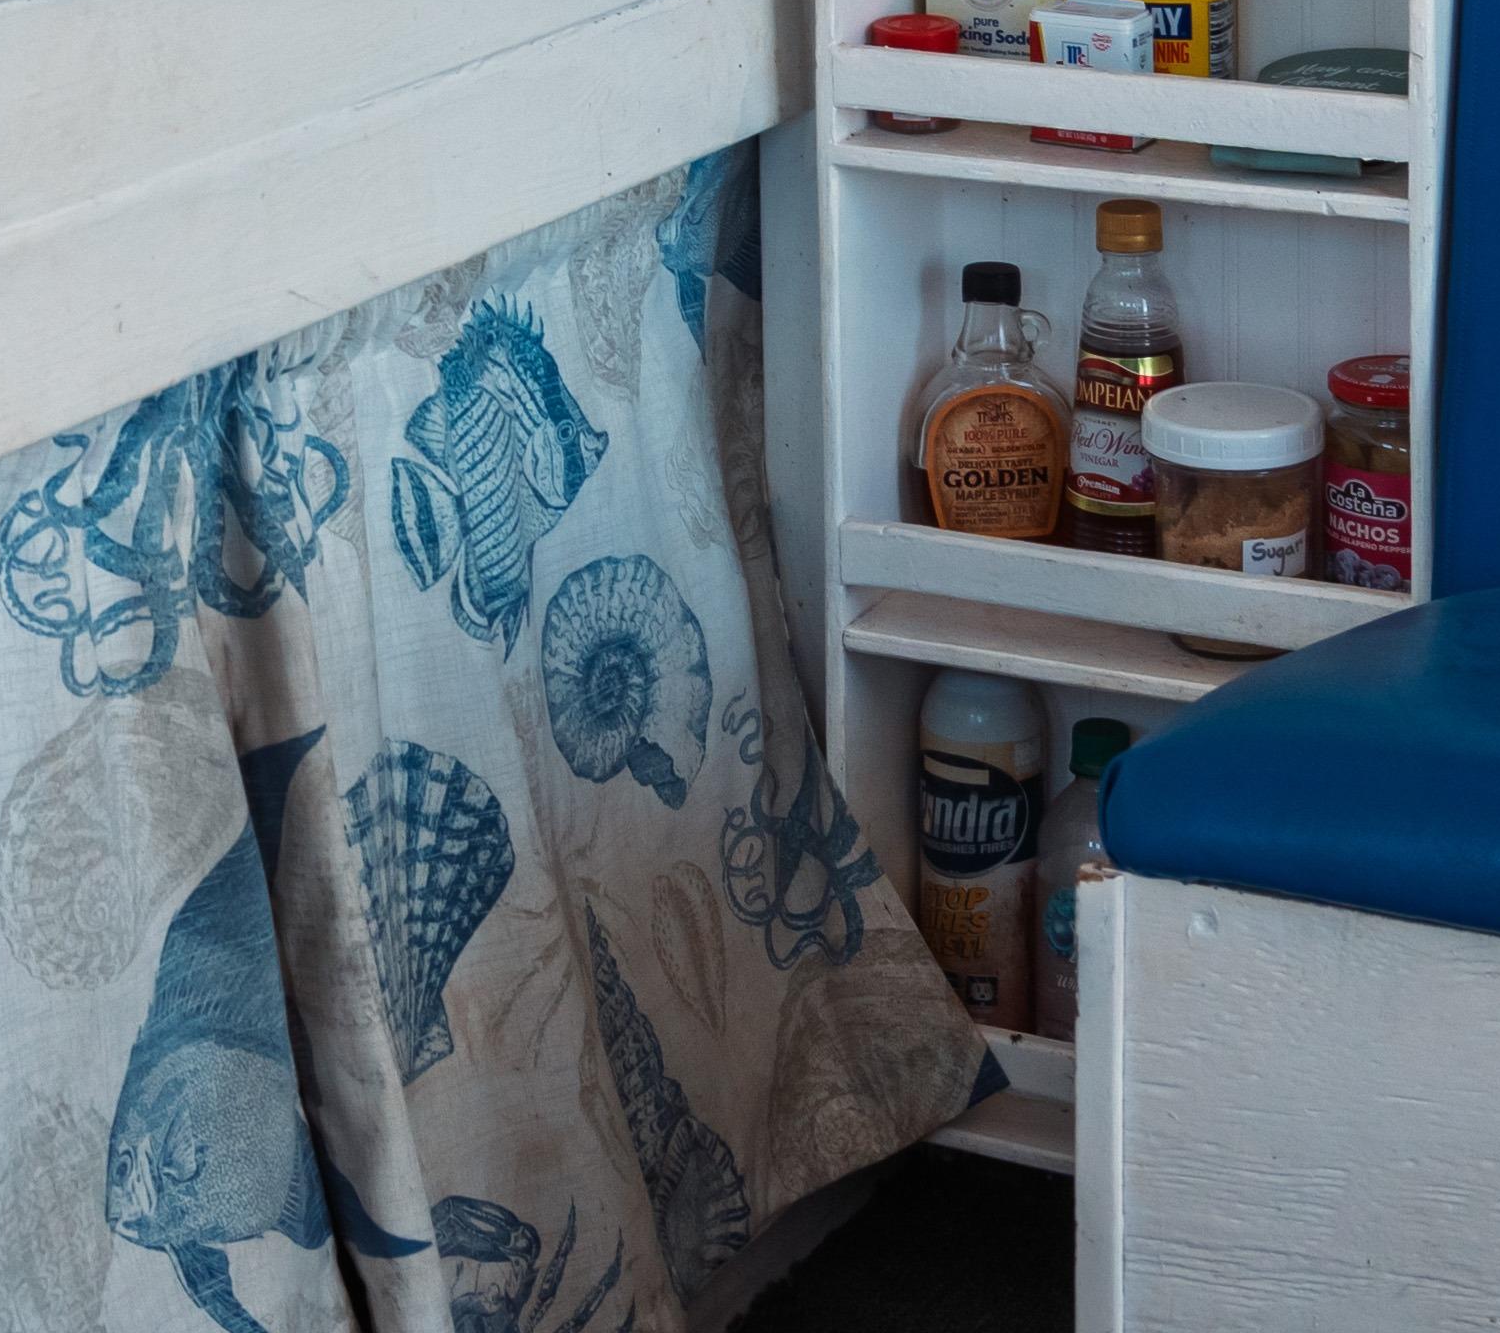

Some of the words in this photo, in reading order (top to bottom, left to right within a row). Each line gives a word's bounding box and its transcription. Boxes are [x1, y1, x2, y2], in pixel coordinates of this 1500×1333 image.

[973, 17, 999, 28] pure
[1151, 7, 1183, 37] AY
[960, 25, 992, 46] king
[996, 427, 1028, 440] PURE
[1080, 453, 1119, 468] VINEGAR
[943, 467, 1048, 489] GOLDEN
[1076, 475, 1121, 495] Premium
[955, 489, 996, 502] MAPLE
[999, 487, 1040, 501] SYRUP
[1350, 483, 1365, 498] La
[1329, 489, 1398, 518] Costeña
[1329, 513, 1400, 544] NACHOS
[1251, 539, 1303, 576] Sugar
